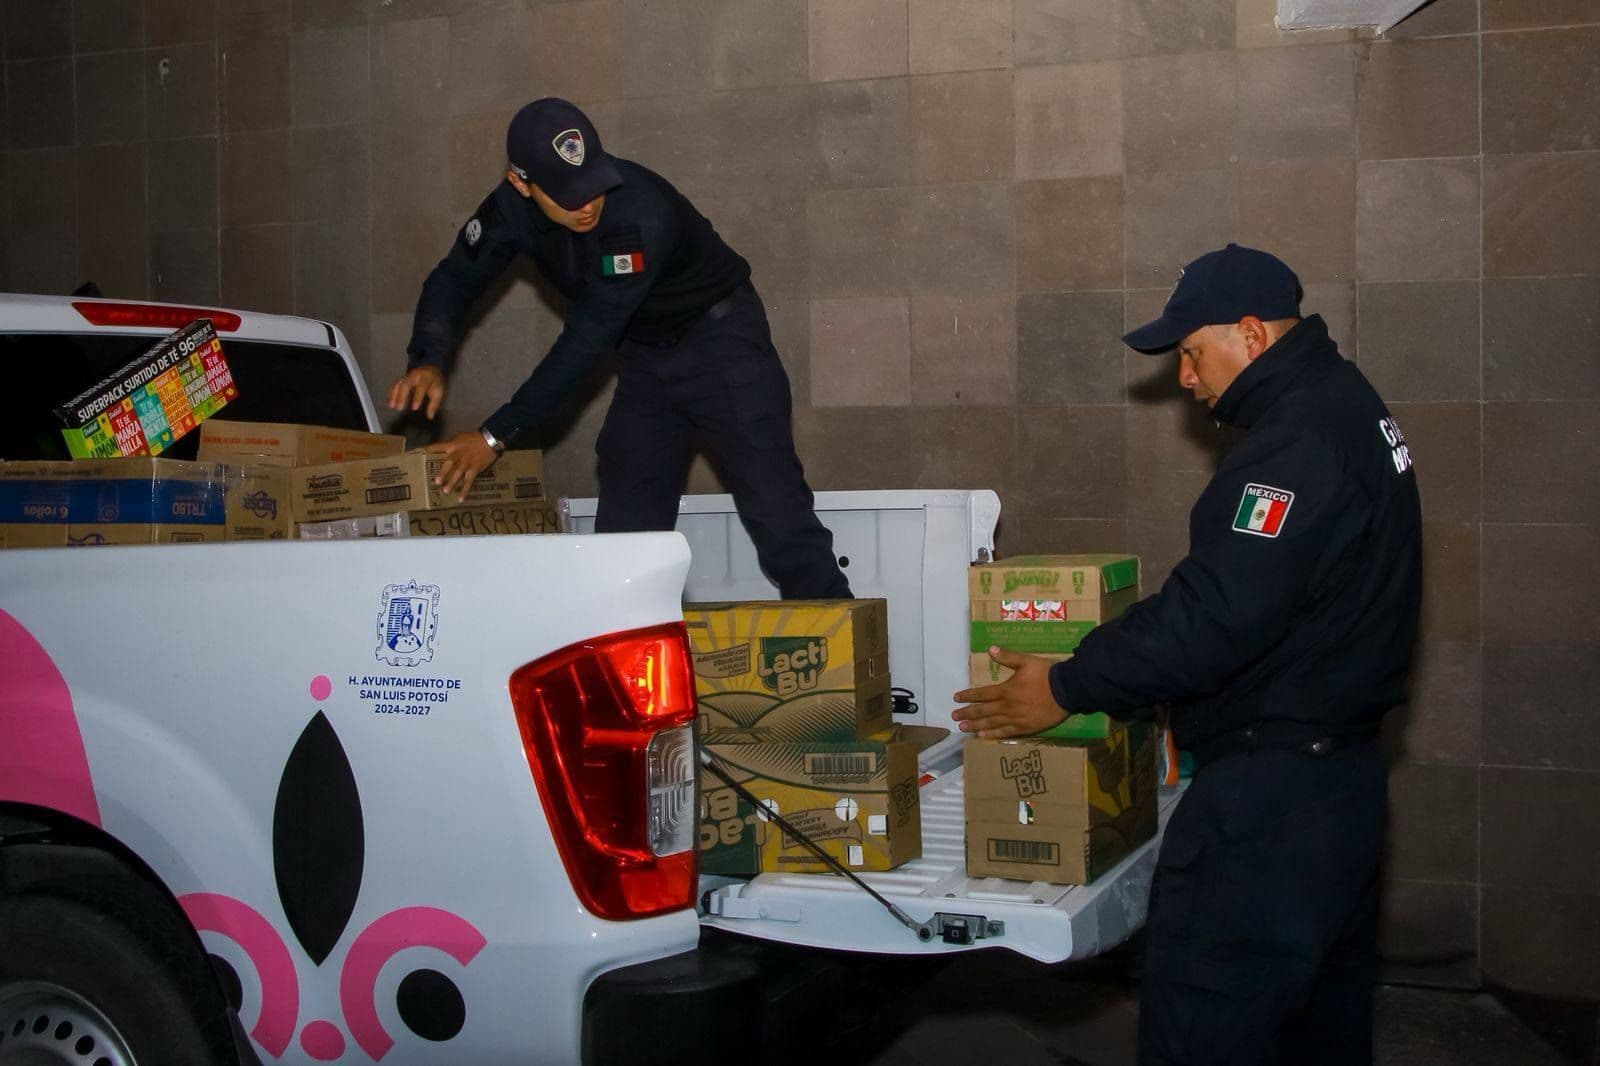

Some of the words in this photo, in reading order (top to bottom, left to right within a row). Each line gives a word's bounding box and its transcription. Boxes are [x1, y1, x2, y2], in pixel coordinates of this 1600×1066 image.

[77, 383, 126, 423] SUPERPACK
[124, 362, 158, 393] SURTIDO
[157, 355, 170, 371] DE
[168, 346, 180, 366] TÉ
[178, 336, 196, 357] 96
[115, 420, 141, 445] MANZA
[120, 434, 143, 457] NILLA
[758, 638, 828, 678] Lacti
[348, 676, 359, 685] H.
[361, 676, 444, 689] AYUNTAMIENTO
[446, 679, 461, 689] DE
[777, 669, 817, 697] Bu
[359, 689, 381, 700] SAN
[383, 691, 406, 701] LUIS
[408, 691, 449, 703] POTOSÍ
[374, 703, 431, 715] 2024-2027
[1000, 749, 1042, 779] Lacti
